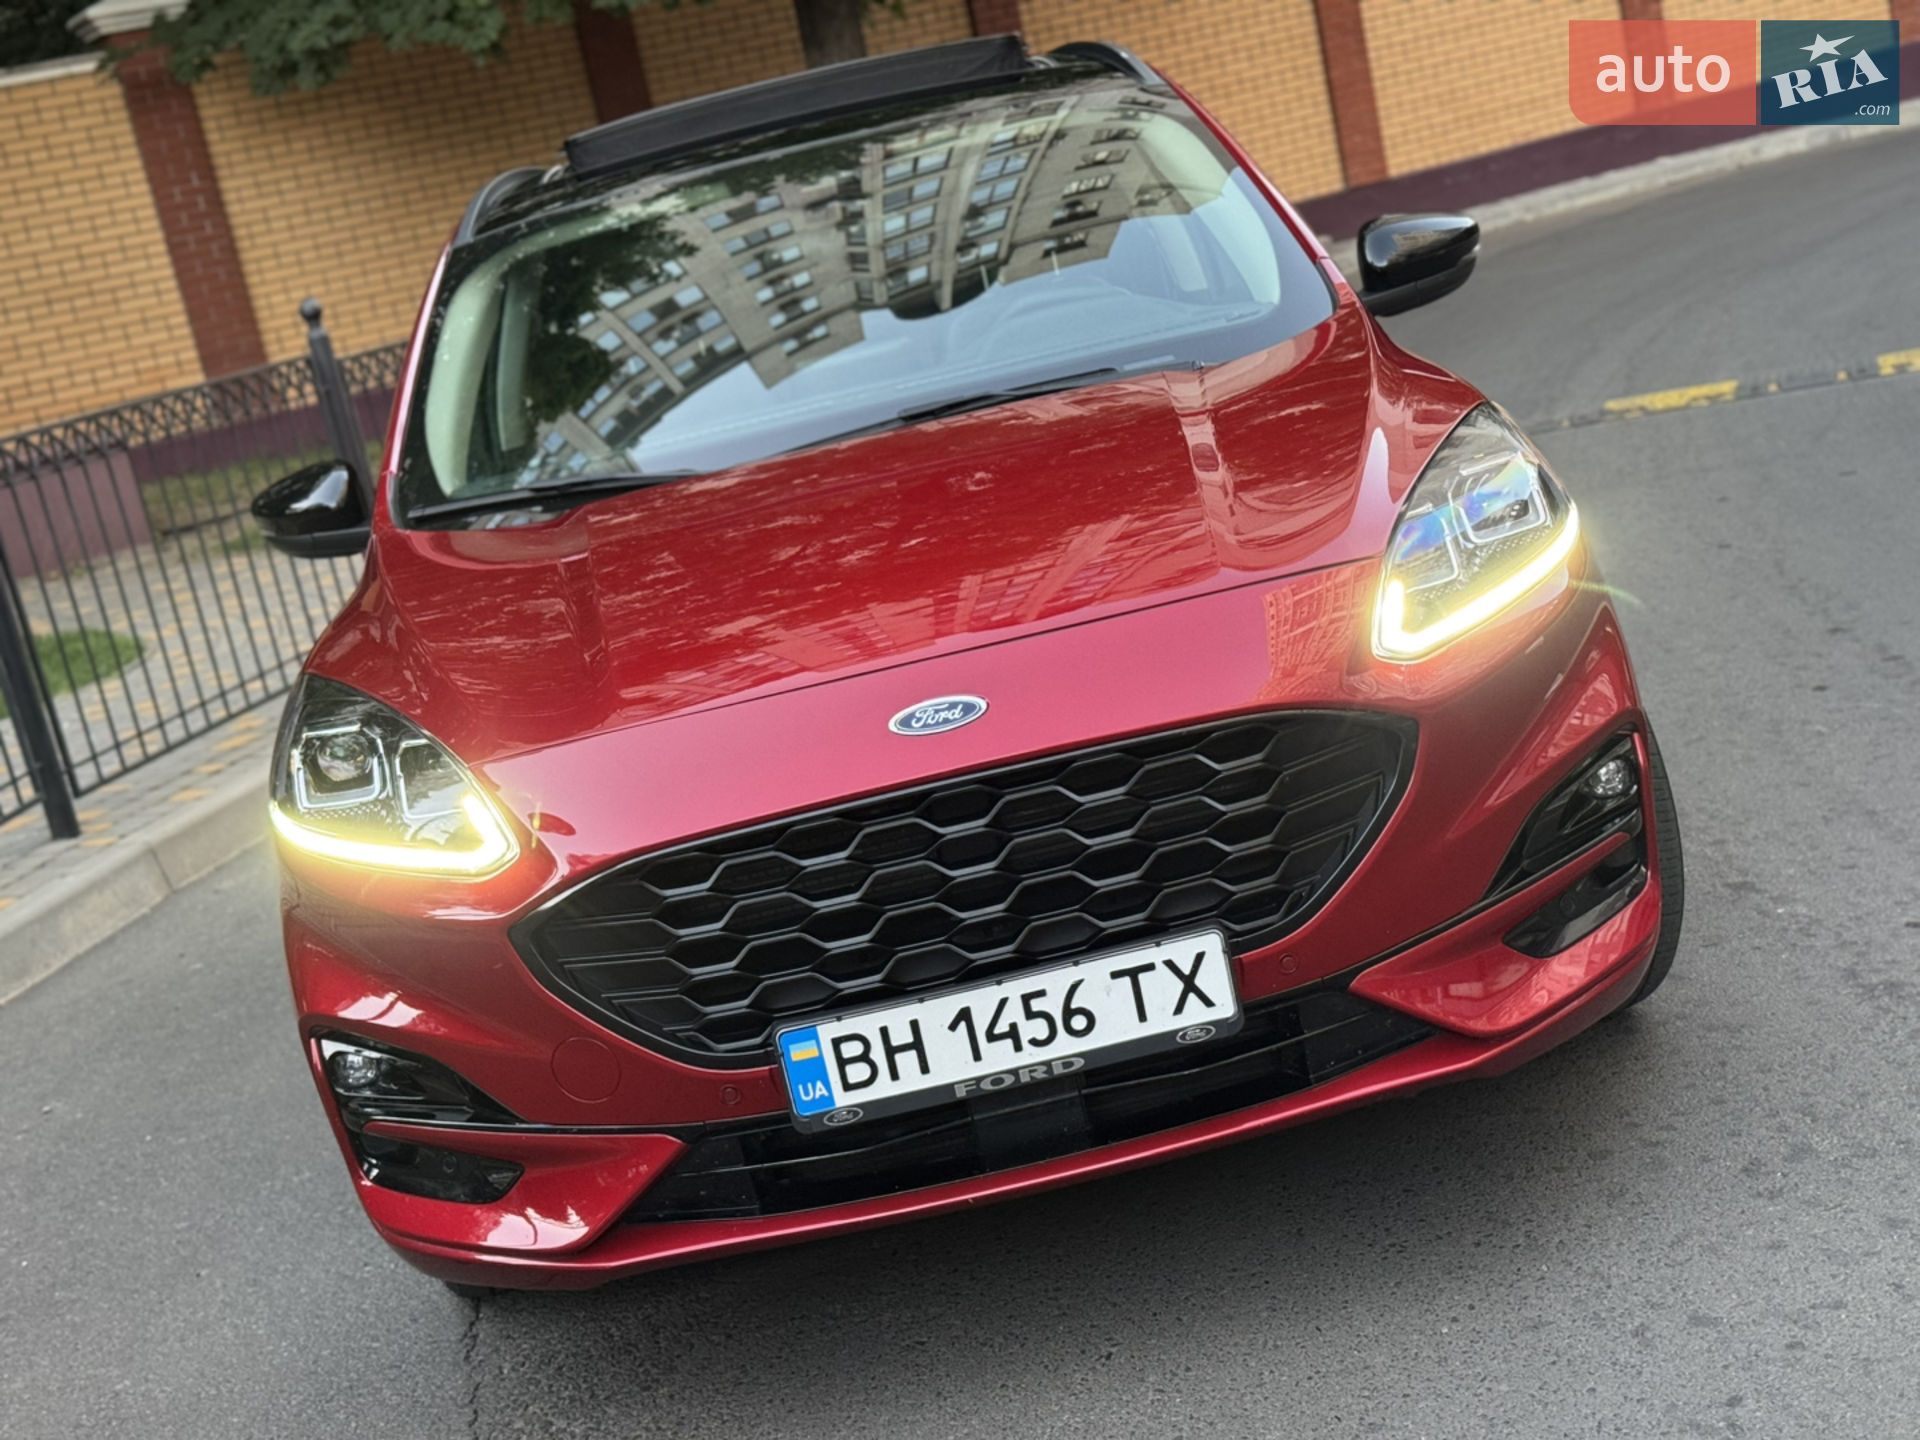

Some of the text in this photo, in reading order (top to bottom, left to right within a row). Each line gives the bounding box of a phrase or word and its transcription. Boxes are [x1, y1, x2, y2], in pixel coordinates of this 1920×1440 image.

[911, 703, 963, 728] Ford
[831, 951, 1216, 1092] BH 1456 TX
[798, 1080, 829, 1101] UA
[954, 1057, 1085, 1098] FORD
